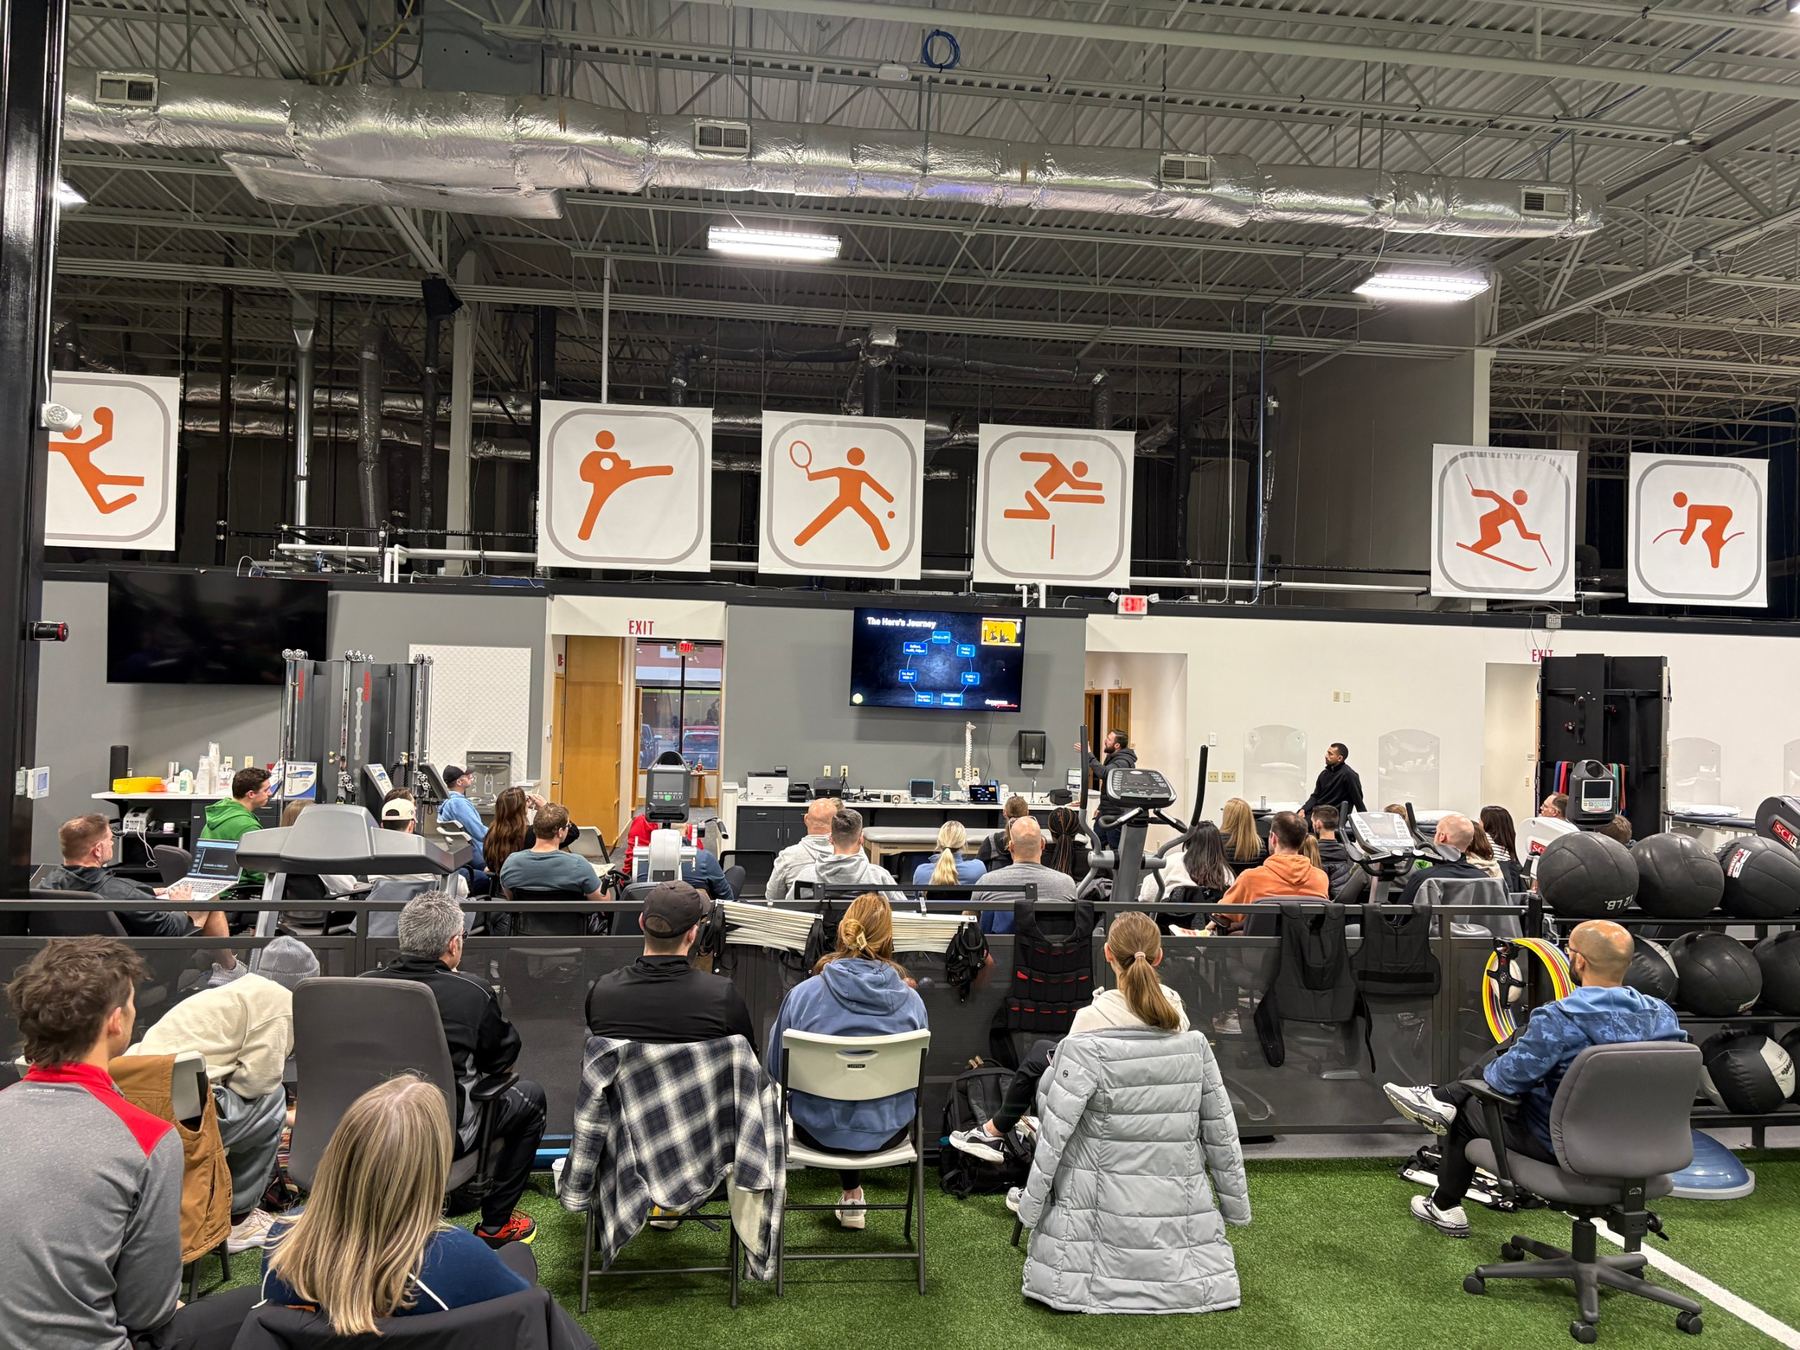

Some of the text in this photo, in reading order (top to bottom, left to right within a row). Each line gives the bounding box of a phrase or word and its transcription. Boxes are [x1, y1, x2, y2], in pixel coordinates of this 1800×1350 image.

[628, 620, 655, 636] EXIT
[866, 616, 881, 626] The
[906, 618, 937, 630] Journey
[1604, 899, 1623, 911] LB.
